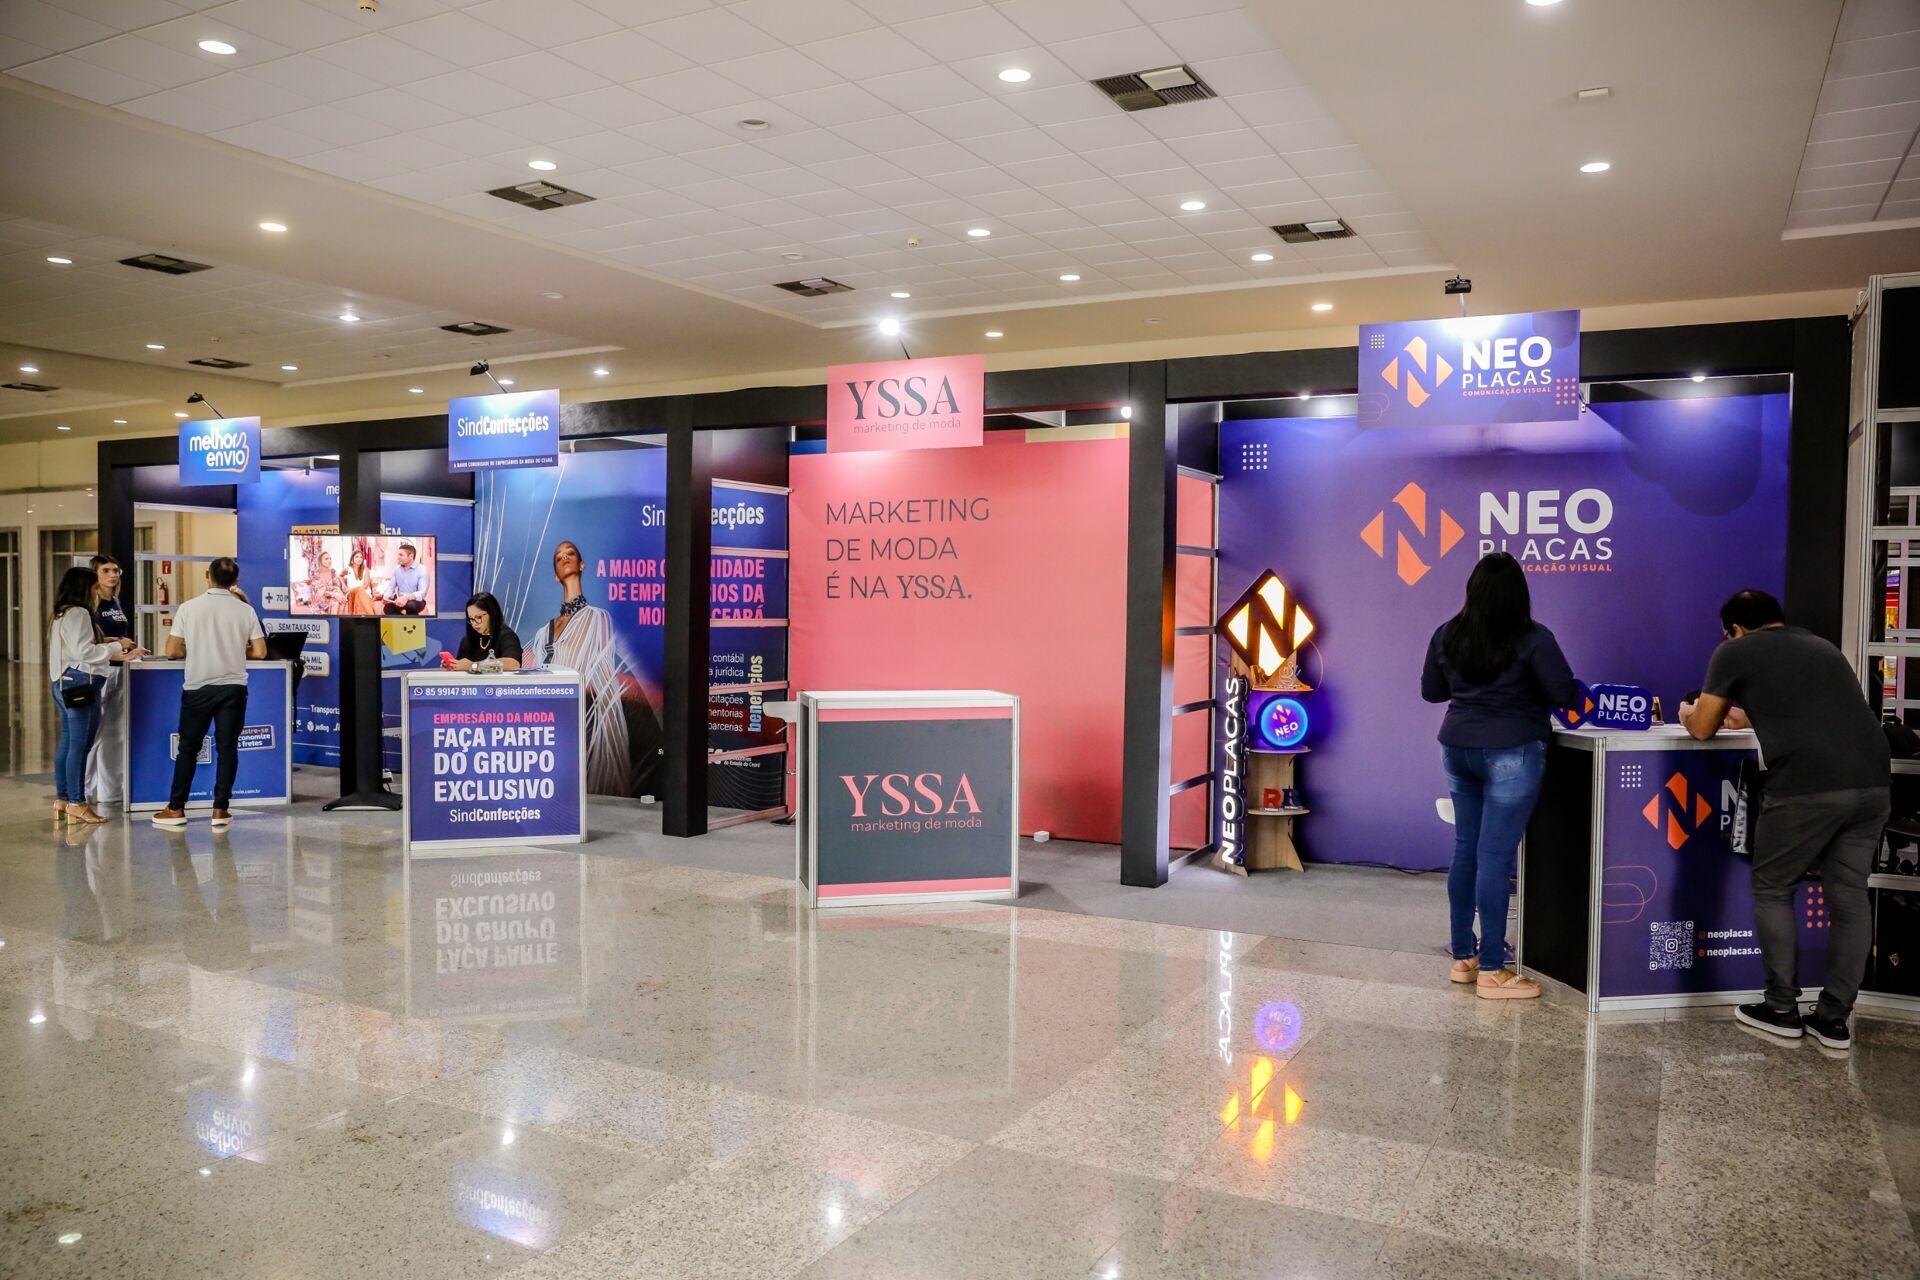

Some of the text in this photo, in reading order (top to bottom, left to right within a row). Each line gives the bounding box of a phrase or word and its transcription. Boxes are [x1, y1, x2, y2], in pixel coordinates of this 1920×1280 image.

[1462, 335, 1552, 371] NEO
[1462, 369, 1552, 389] PLACAS
[845, 375, 961, 420] YSSA
[1462, 386, 1552, 397] COMUNICAÇÃO VISUAL
[457, 412, 549, 437] SindConfecções
[853, 417, 961, 435] marketing de moda
[189, 427, 238, 451] melhor
[206, 450, 246, 467] envio
[641, 502, 765, 530] Sinecções
[826, 497, 990, 525] MARKETING
[1479, 488, 1614, 535] NEO
[826, 537, 958, 561] DE MODA
[596, 559, 606, 578] A
[609, 559, 656, 578] MAIOR
[1522, 562, 1613, 575] ICAÇÃO VISUAL
[608, 582, 627, 601] DE
[742, 584, 765, 603] DA
[826, 569, 972, 599] É NA YSSA.
[276, 594, 283, 602] 70
[278, 623, 320, 632] SEM TAXAS OU
[712, 653, 744, 663] contábil
[715, 666, 744, 678] jurídica
[425, 687, 478, 696] 85 99147 9110
[495, 686, 574, 698] @sindconfeccoesce
[708, 694, 744, 706] icitações
[1598, 693, 1647, 713] NEO
[433, 711, 555, 724] EMPRESÁRIO DA MODA
[1598, 710, 1646, 723] PLACAS
[238, 733, 271, 741] conomize
[1274, 722, 1298, 737] NEO
[433, 726, 556, 752] FAÇA PARTE
[434, 750, 555, 775] DO GRUPO
[1222, 677, 1240, 865] NEOPLACAS
[434, 778, 555, 802] EXCLUSIVO
[838, 772, 983, 818] YSSA
[450, 806, 541, 823] SindConfecções
[851, 816, 982, 833] marketing de moda
[1707, 928, 1753, 940] neoplacas
